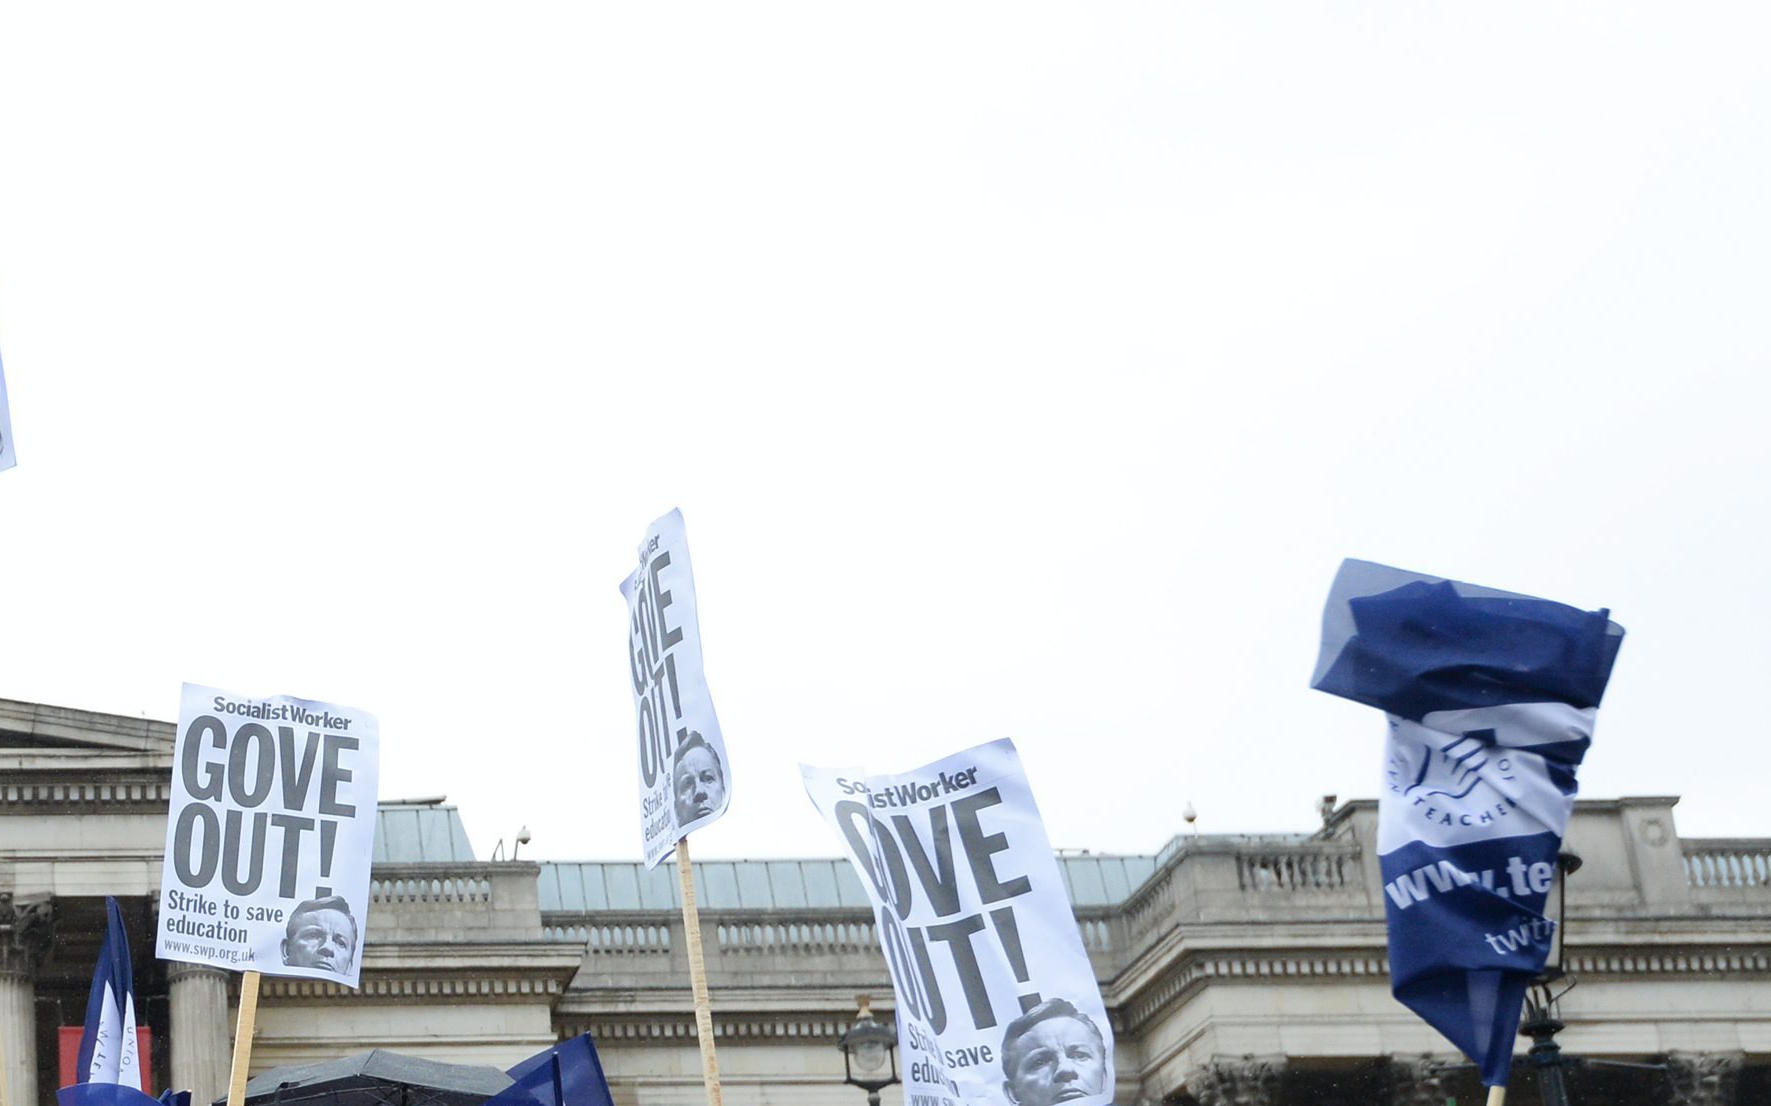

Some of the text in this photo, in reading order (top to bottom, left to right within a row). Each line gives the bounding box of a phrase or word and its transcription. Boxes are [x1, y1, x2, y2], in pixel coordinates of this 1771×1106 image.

[181, 714, 360, 818] GOVE
[173, 802, 338, 899] OUT!
[168, 889, 283, 923] Strike to save
[166, 915, 248, 943] education
[164, 939, 255, 964] www.swp.org.uk
[945, 1045, 993, 1068] save
